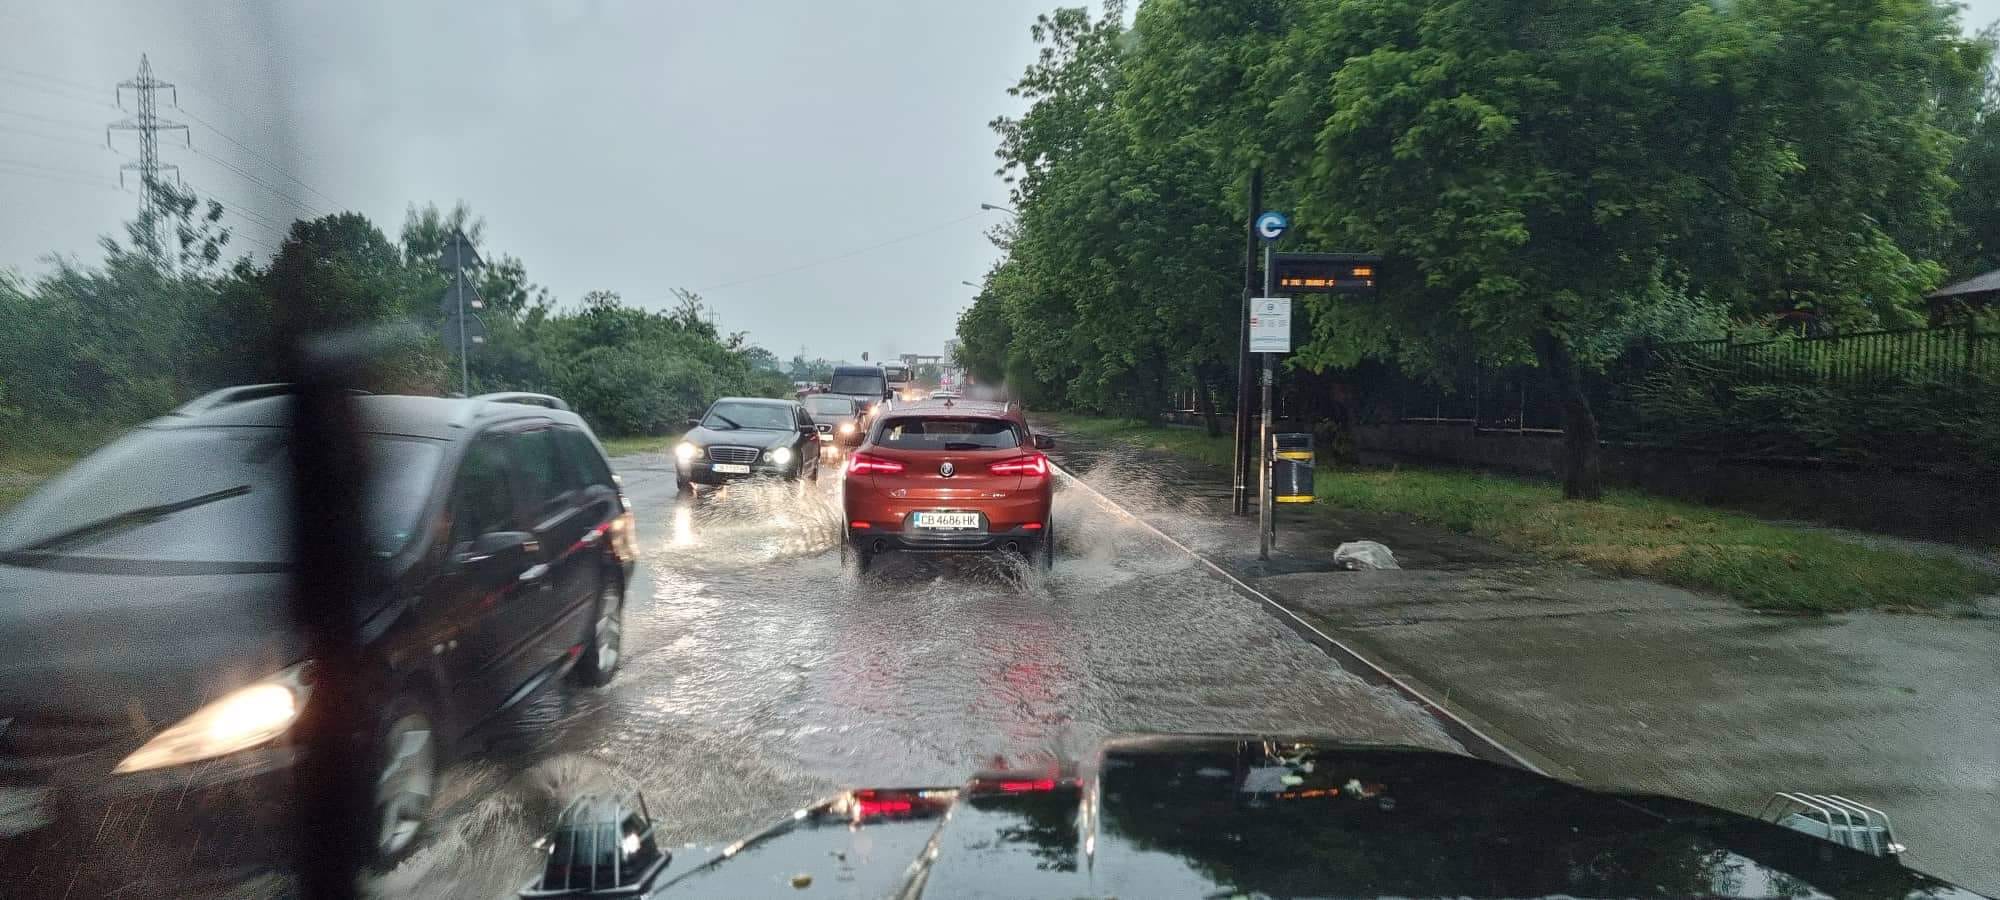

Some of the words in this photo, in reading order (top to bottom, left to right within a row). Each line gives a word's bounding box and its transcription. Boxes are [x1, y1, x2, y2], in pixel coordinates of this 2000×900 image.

[921, 514, 935, 525] CB
[936, 515, 961, 526] 4686
[962, 515, 977, 526] HK
